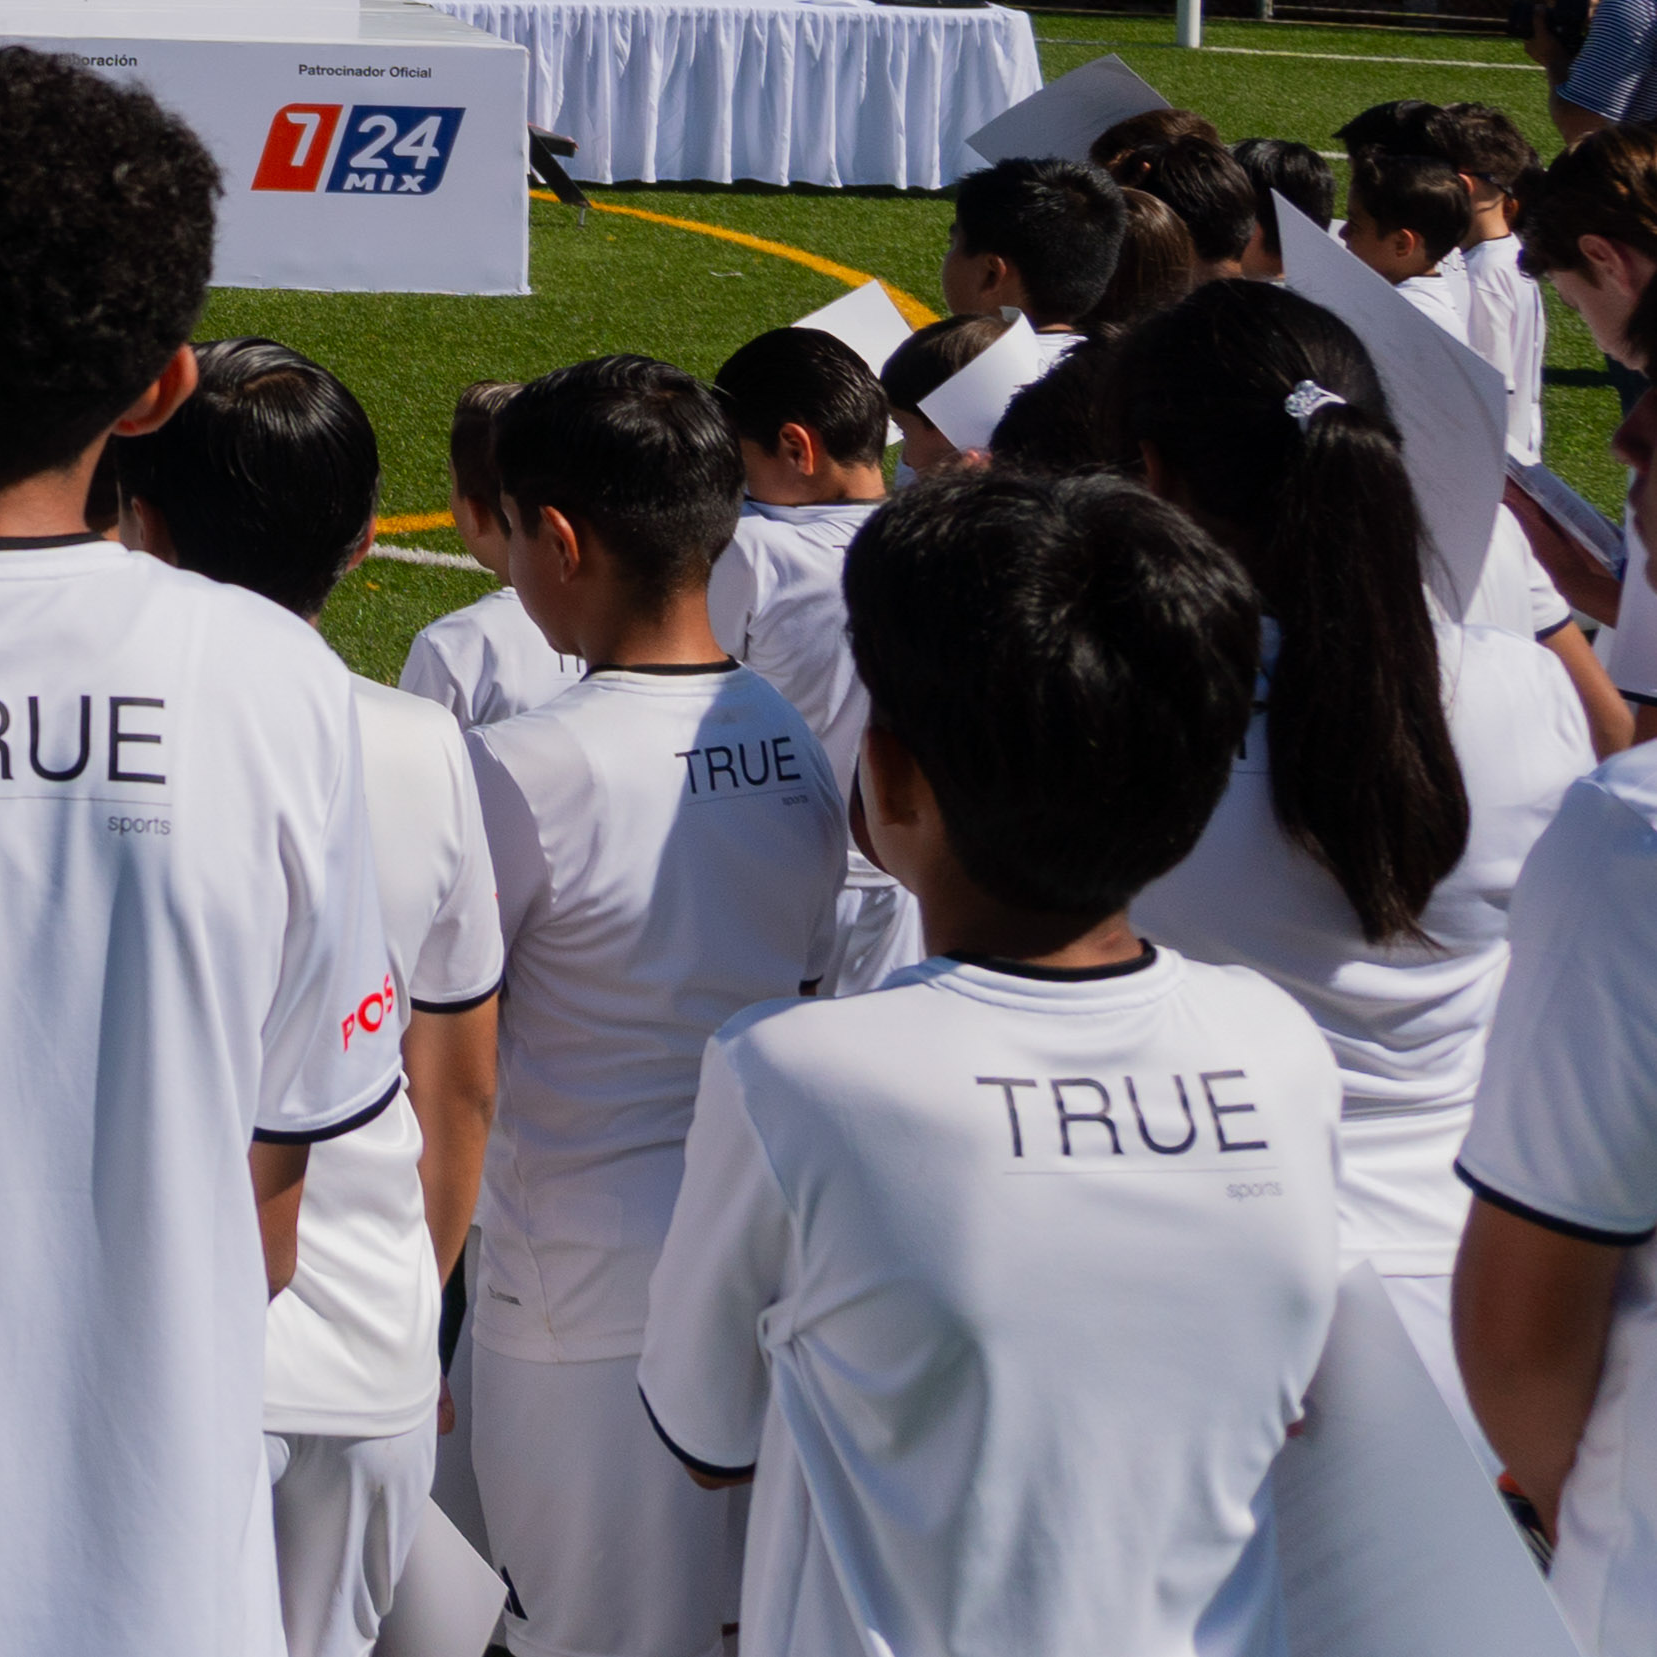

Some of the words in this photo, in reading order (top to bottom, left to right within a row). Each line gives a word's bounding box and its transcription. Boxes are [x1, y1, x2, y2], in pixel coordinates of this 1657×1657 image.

[299, 64, 386, 77] Patrocinador
[389, 66, 431, 78] Oficial
[349, 116, 442, 170] 24
[343, 173, 426, 192] MIX
[675, 736, 801, 794] TRUE
[107, 813, 172, 840] sports
[976, 1070, 1269, 1158] TRUE
[1225, 1177, 1283, 1201] sports
